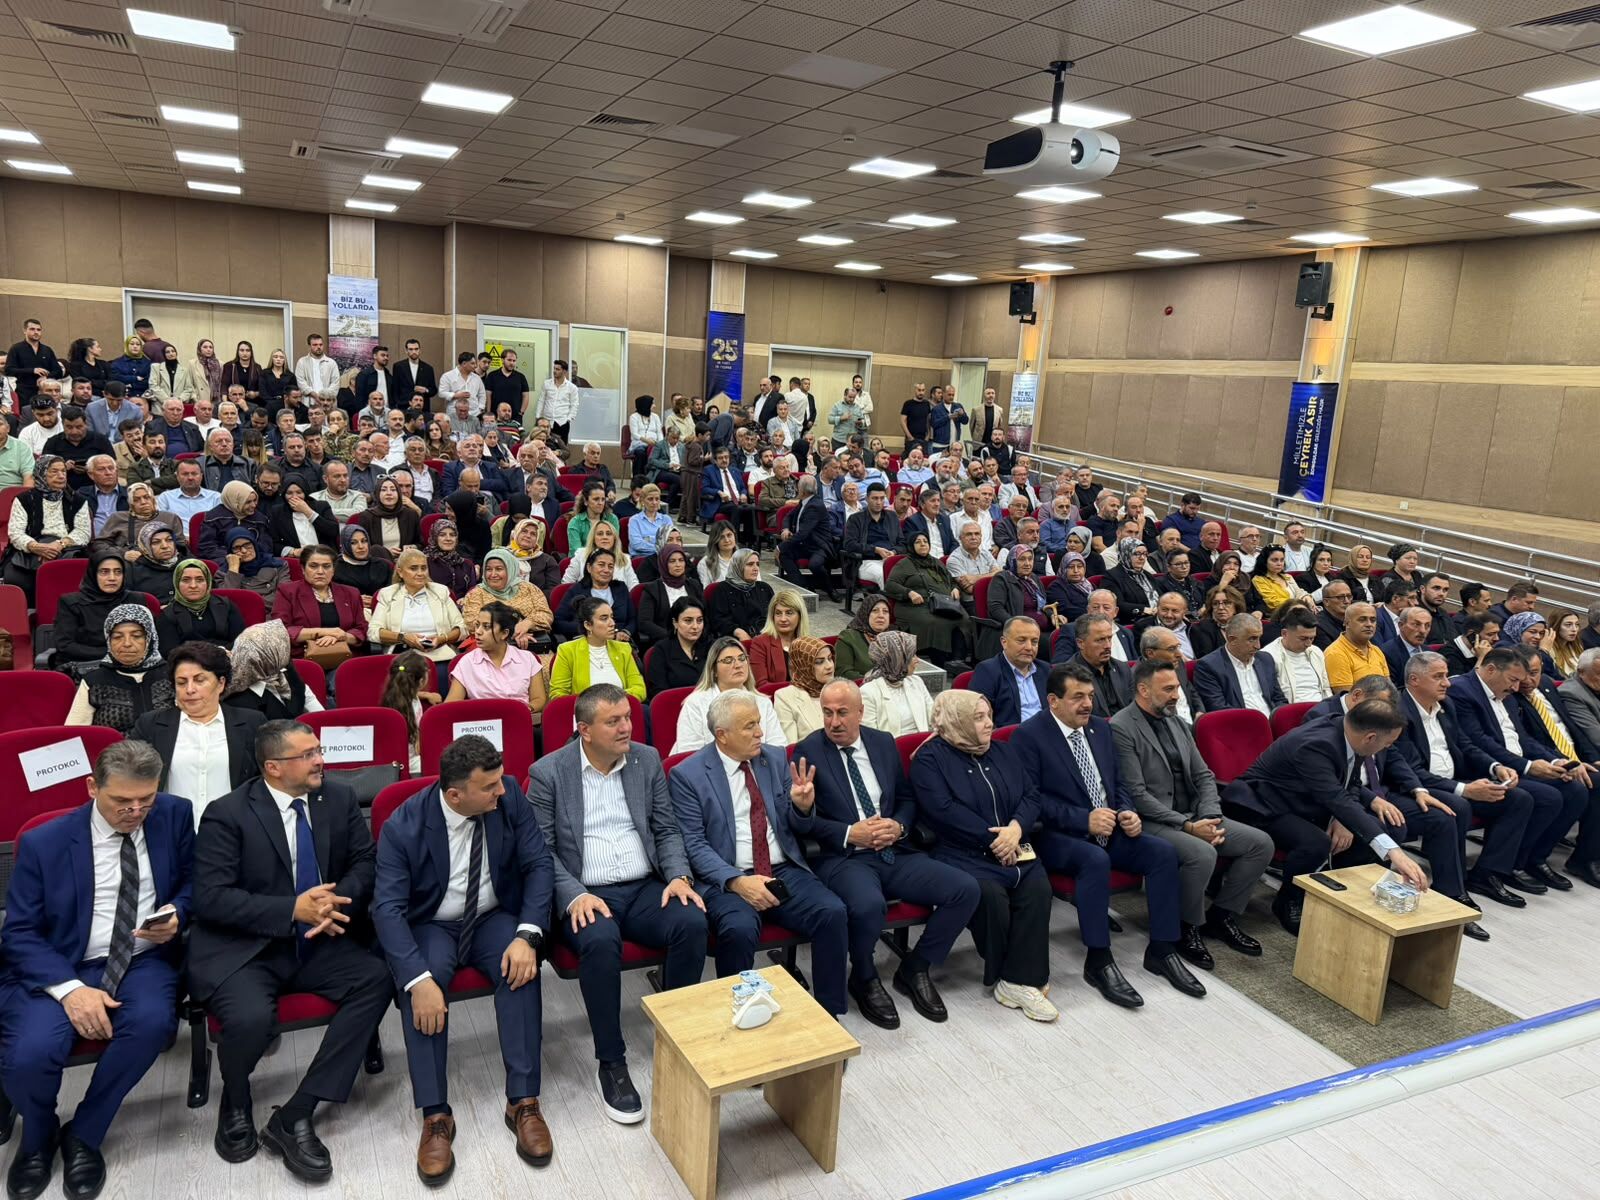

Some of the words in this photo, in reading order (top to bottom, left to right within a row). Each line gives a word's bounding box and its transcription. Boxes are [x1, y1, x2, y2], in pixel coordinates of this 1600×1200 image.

[332, 302, 374, 311] YOLLARDA
[711, 338, 738, 361] 25
[1293, 407, 1307, 465] MİLLETİMİZLE
[1299, 428, 1313, 477] ÇEYREK
[1306, 396, 1318, 426] ASIR
[461, 725, 495, 733] PROTOKOL
[328, 744, 366, 752] PROTOKOL
[36, 759, 80, 777] PROTOKOL
